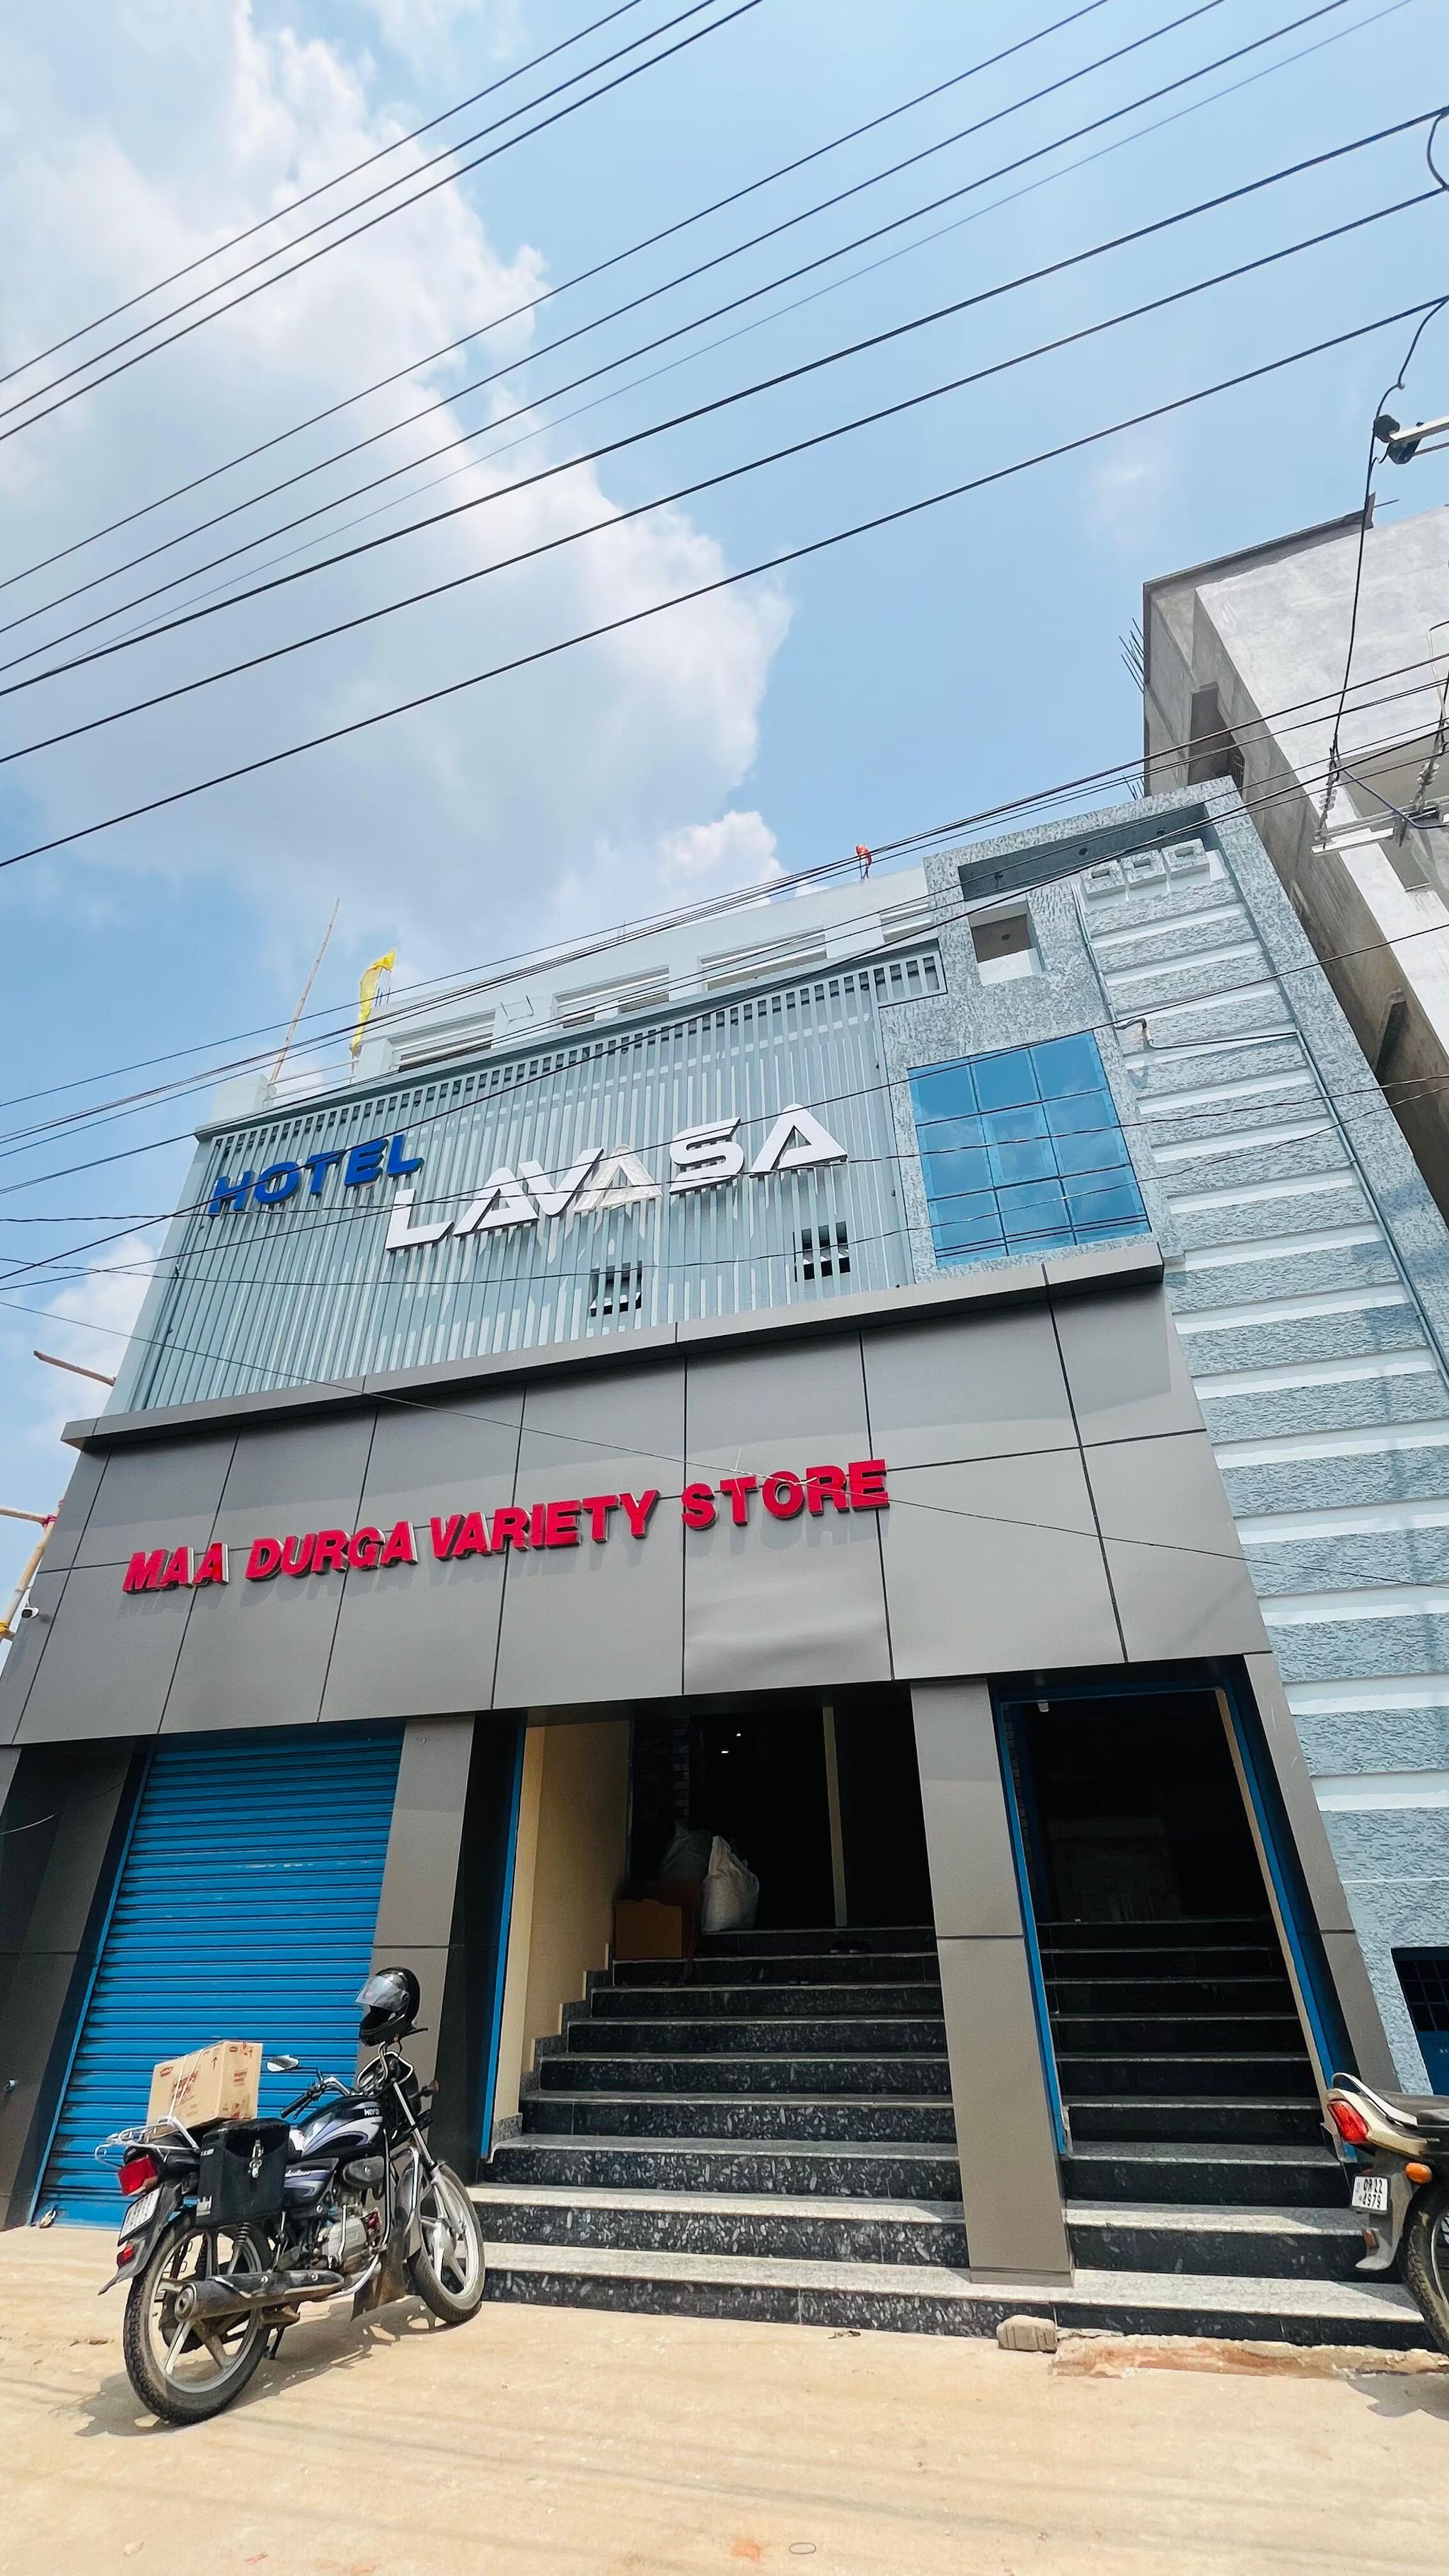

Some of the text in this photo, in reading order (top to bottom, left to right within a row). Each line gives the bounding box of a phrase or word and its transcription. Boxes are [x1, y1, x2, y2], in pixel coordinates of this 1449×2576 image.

[208, 1133, 425, 1217] HOTEL
[386, 1102, 848, 1252] LAVASA
[122, 1458, 890, 1594] MAA DURGA VARIETY STORE
